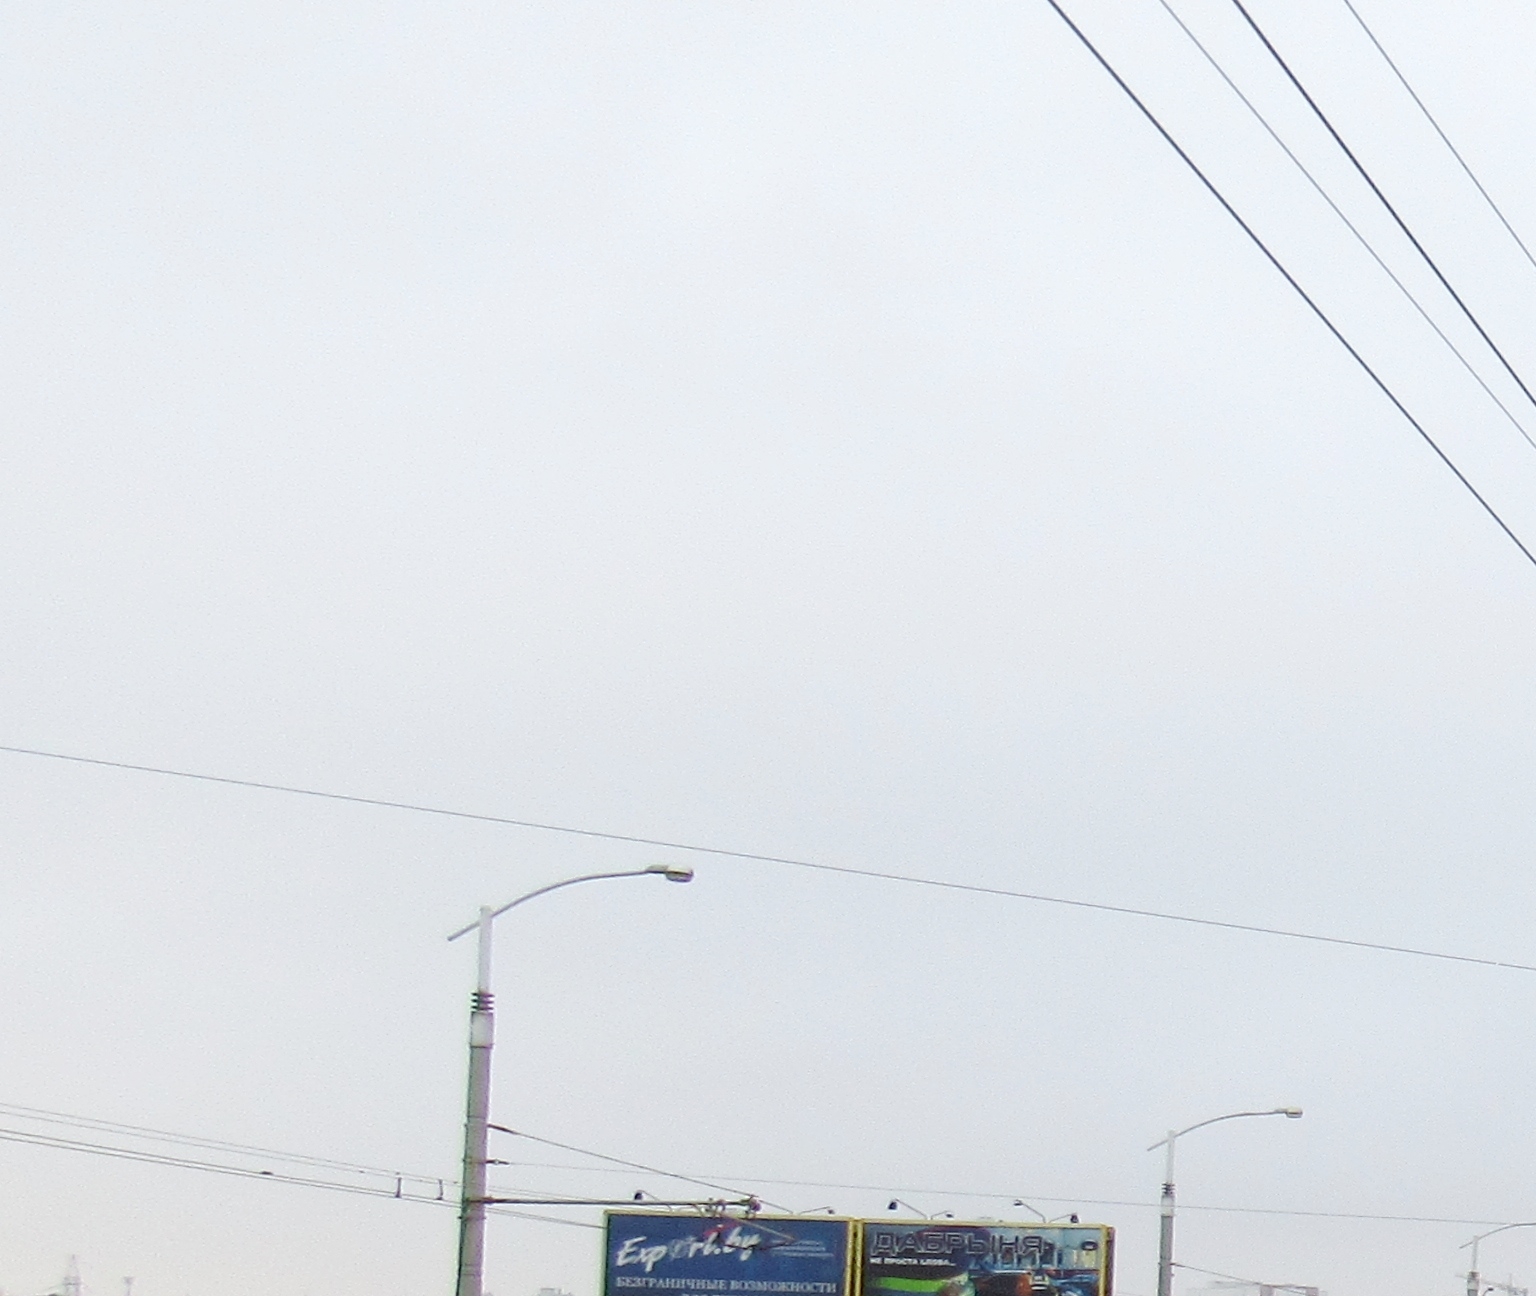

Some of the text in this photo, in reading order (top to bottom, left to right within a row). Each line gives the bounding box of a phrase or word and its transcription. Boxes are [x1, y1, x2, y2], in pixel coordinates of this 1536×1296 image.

[870, 1230, 1045, 1257] ДАБРЫНЯ
[616, 1276, 837, 1294] БЕЗГРАНИЧНЫЕ ВОЗМОЖНОСТИ
